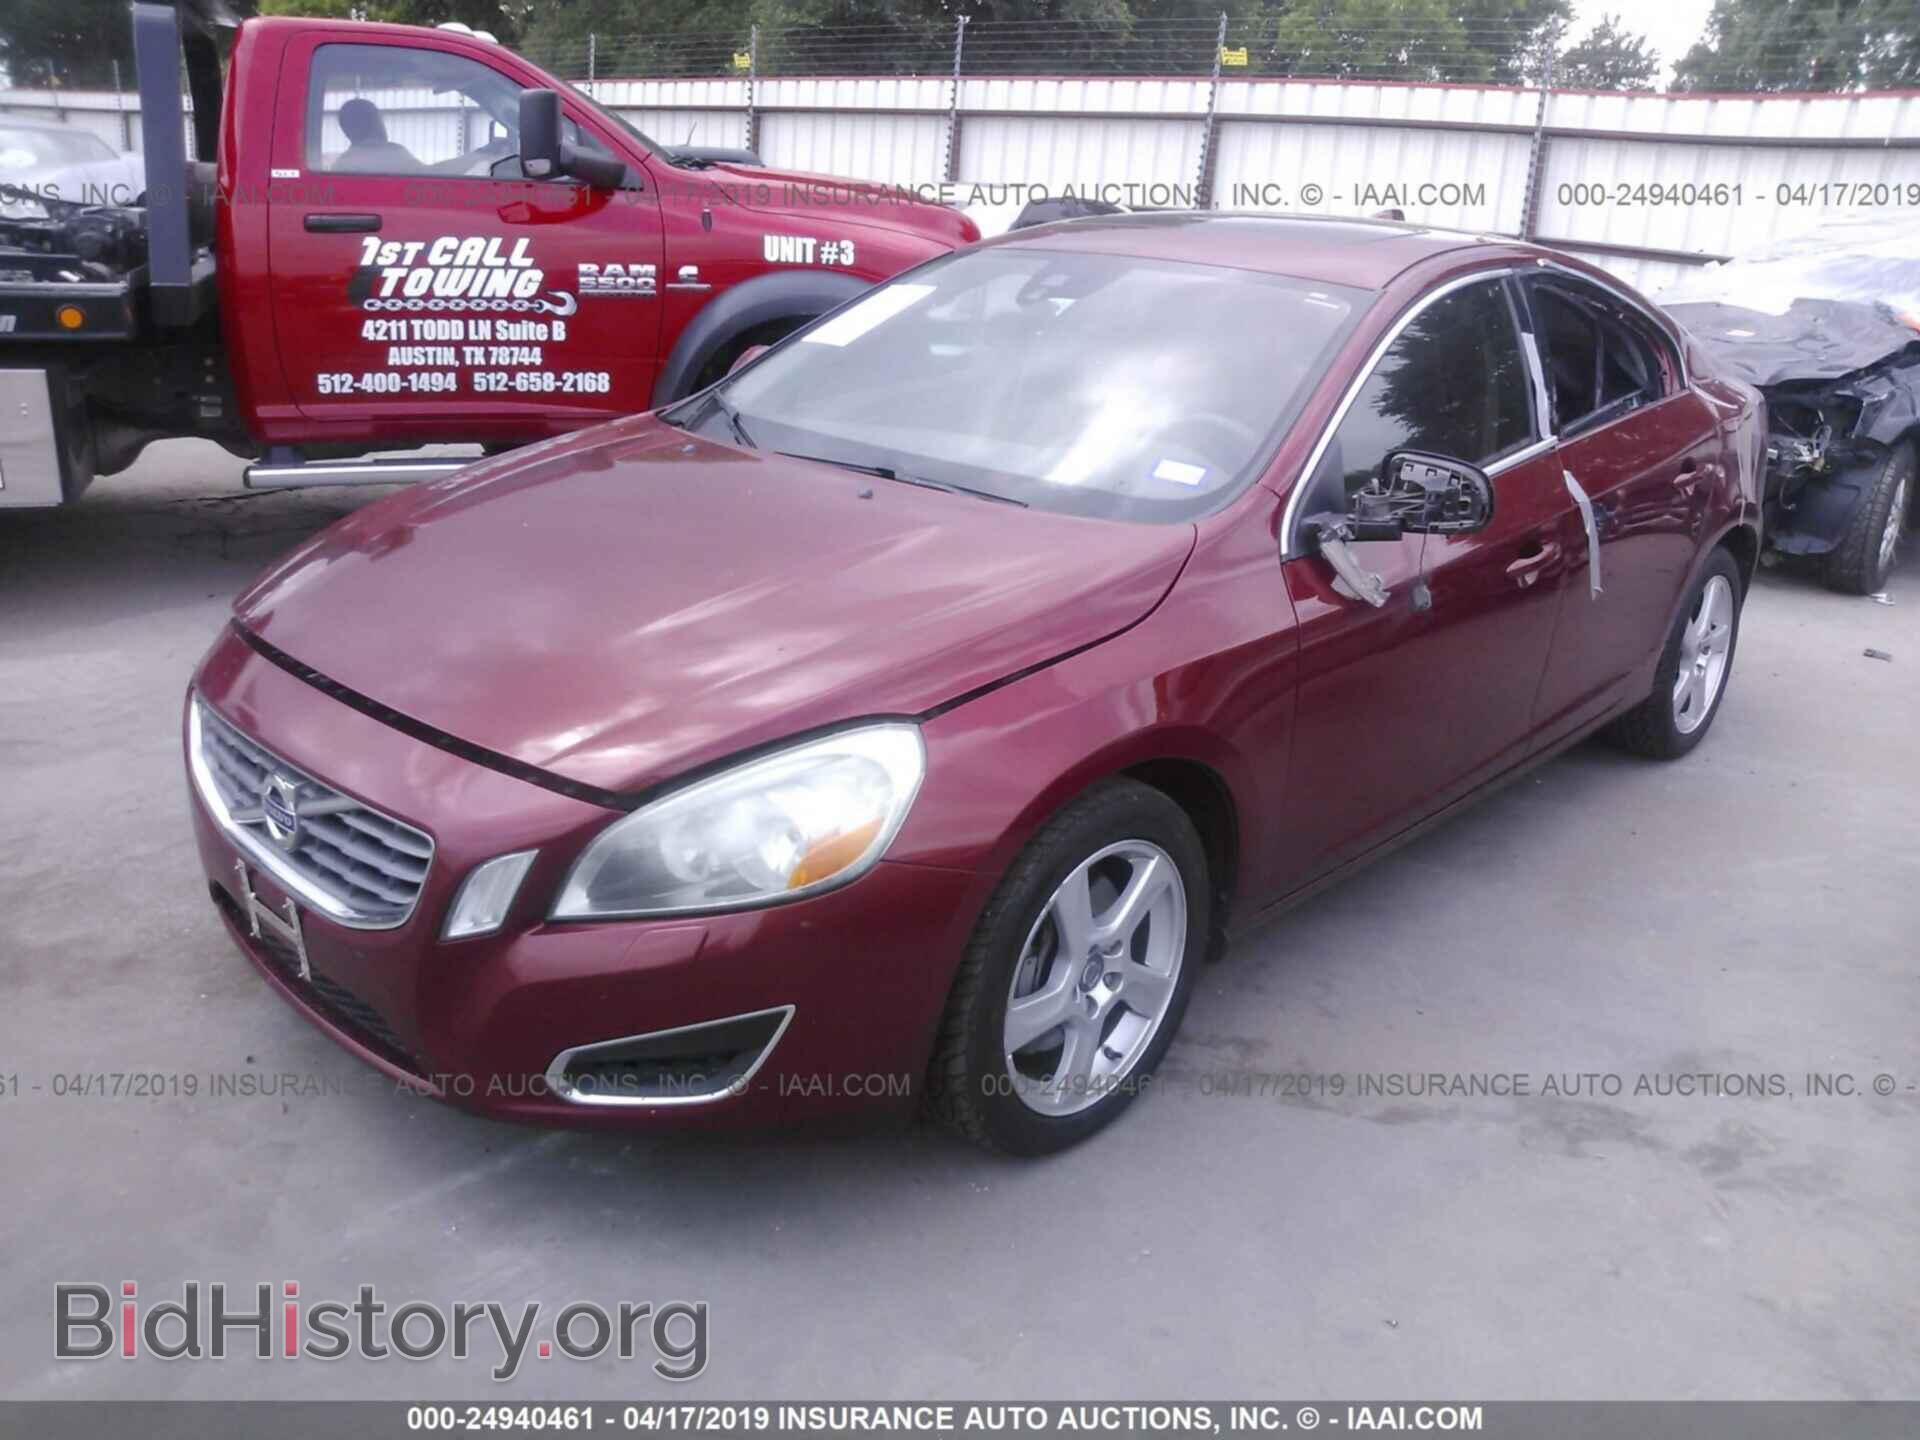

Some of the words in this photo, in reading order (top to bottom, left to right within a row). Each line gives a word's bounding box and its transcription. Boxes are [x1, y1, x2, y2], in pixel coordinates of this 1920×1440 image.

[427, 236, 536, 267] CALL
[763, 235, 816, 263] UNIT
[820, 240, 855, 265] #3
[578, 263, 657, 276] RAM
[379, 267, 544, 298] TOWING
[578, 276, 657, 290] 5500
[361, 320, 407, 341] 4211
[411, 320, 465, 341] TODD
[469, 320, 494, 341] LN
[496, 320, 548, 341] Suite
[552, 321, 566, 341] B
[388, 346, 459, 367] AUSTIN,
[462, 346, 486, 366] TX
[489, 346, 542, 366] 78744
[317, 373, 457, 393] 512-400-1494
[473, 372, 610, 393] 512-658-2168
